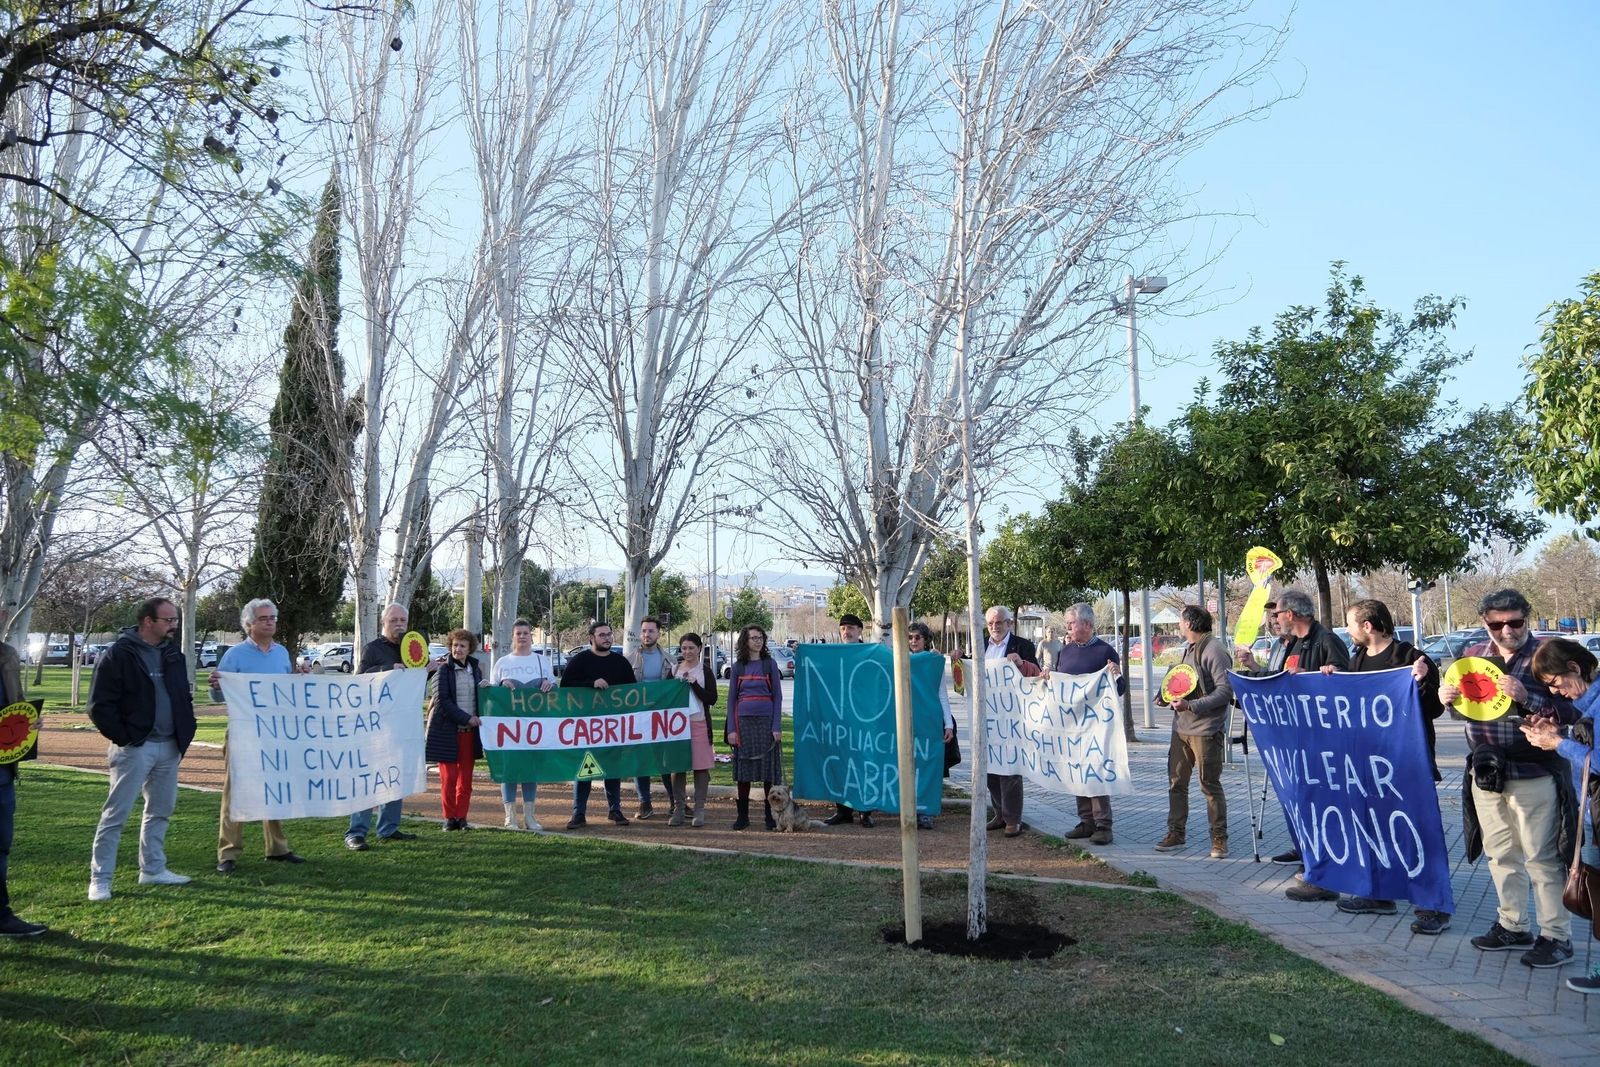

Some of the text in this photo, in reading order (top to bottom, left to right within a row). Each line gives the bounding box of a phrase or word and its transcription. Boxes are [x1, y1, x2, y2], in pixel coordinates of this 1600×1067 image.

[249, 677, 393, 709] ENERGÍA
[802, 656, 892, 722] NO
[256, 711, 381, 740] NUCLEAR
[497, 710, 688, 747] NO CABRIL NO
[1059, 696, 1115, 727] MAS
[1241, 692, 1394, 729] CEMENTERIO
[261, 748, 368, 771] NI CIVIL
[801, 721, 929, 761] AMPLIACIN
[264, 765, 401, 805] NI MILITAR
[822, 755, 928, 810] CABRL
[1068, 758, 1117, 785] MAS
[1264, 745, 1404, 801] NUCLEAR
